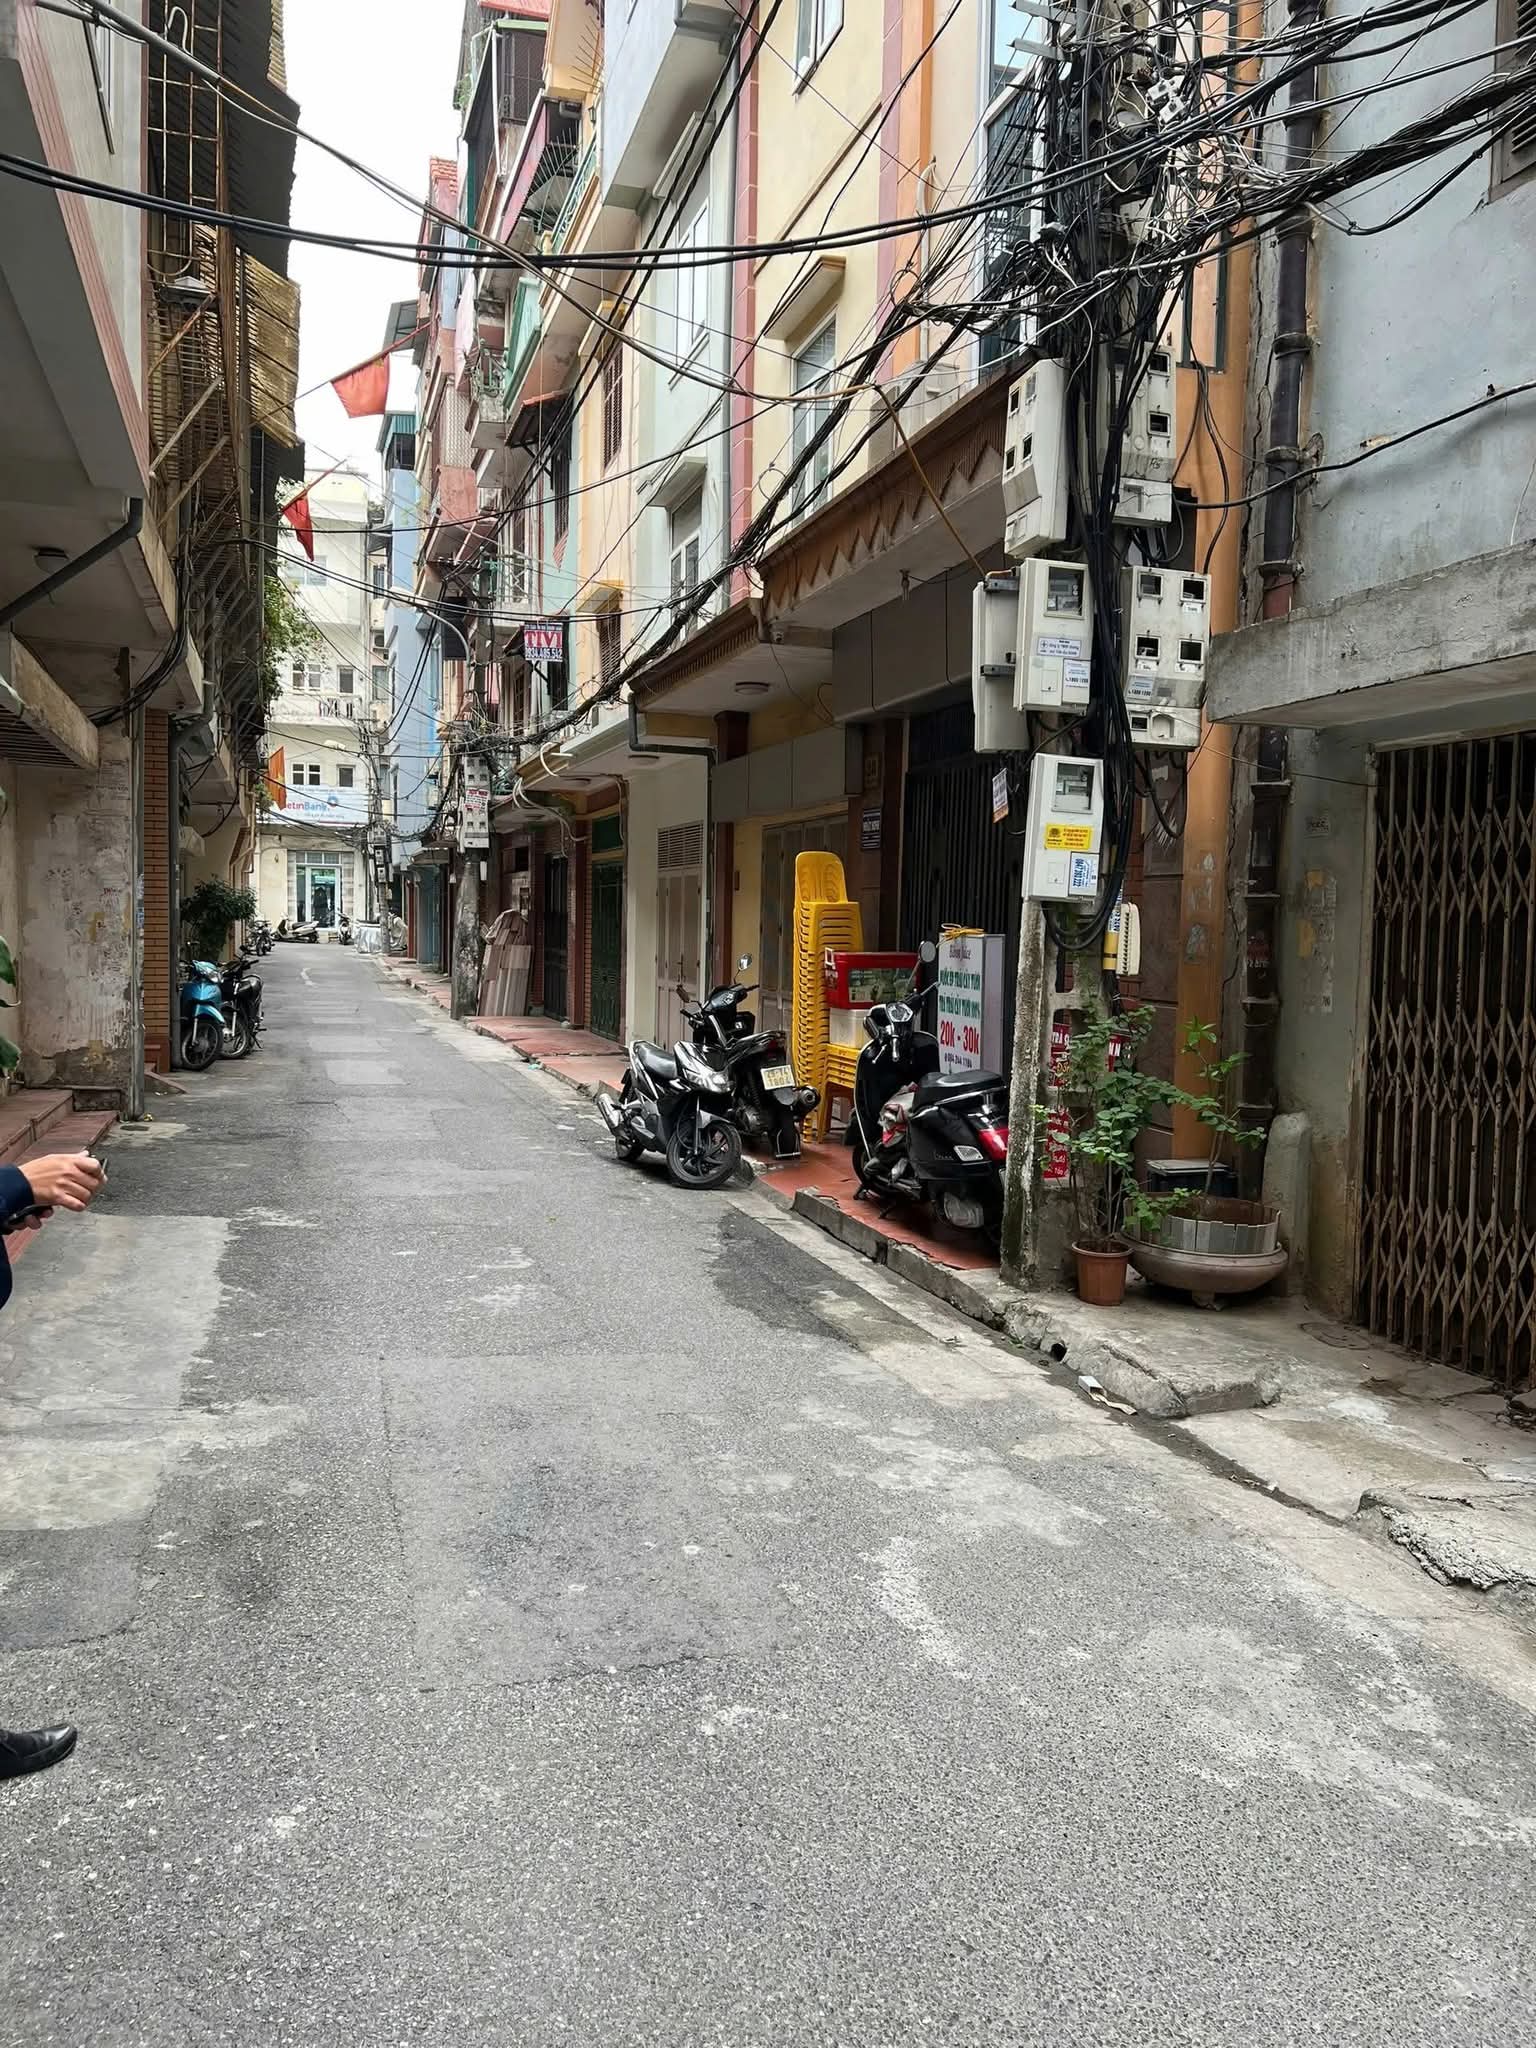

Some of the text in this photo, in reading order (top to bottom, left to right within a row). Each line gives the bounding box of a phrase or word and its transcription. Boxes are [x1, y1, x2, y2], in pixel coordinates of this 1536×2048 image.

[525, 630, 562, 648] TIVI
[287, 801, 328, 811] etinBank
[940, 1020, 955, 1047] 20k
[963, 1025, 979, 1055] 30k
